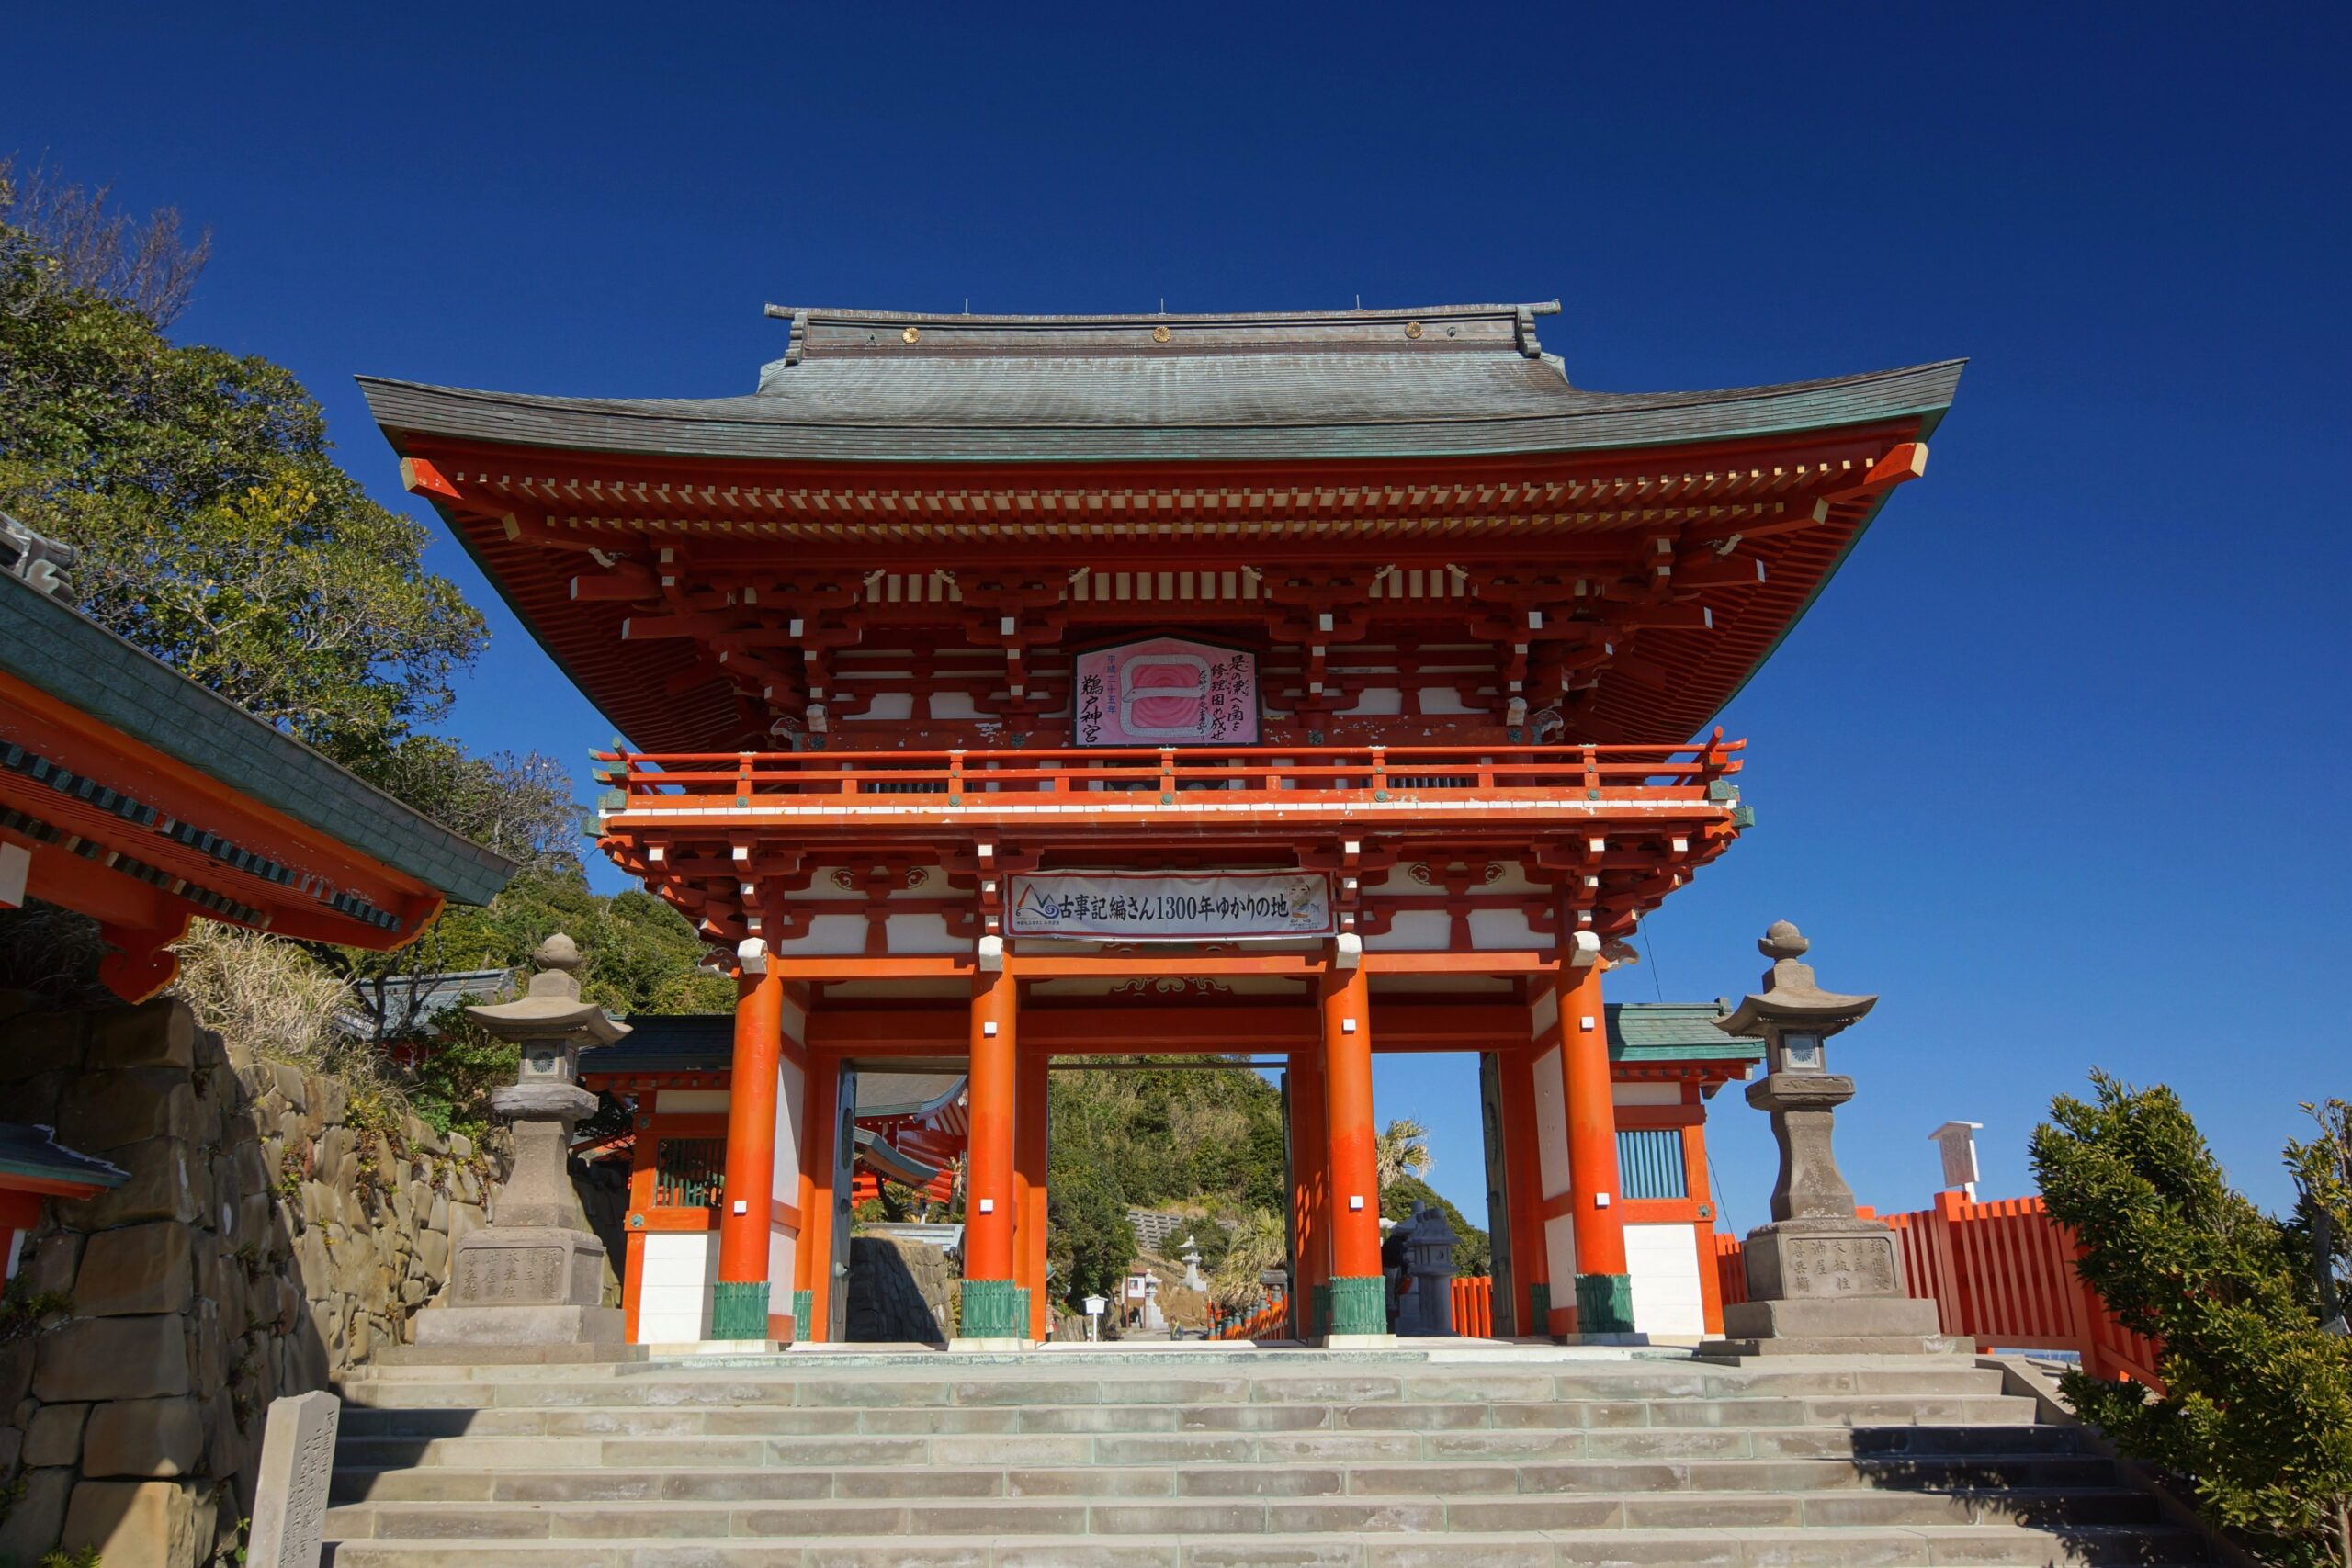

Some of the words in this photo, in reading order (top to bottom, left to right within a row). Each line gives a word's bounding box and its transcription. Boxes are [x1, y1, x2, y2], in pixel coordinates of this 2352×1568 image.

[1107, 655, 1116, 714] 平成二十五年
[1058, 893, 1290, 923] 古事記編さん1300年ゆかりの地
